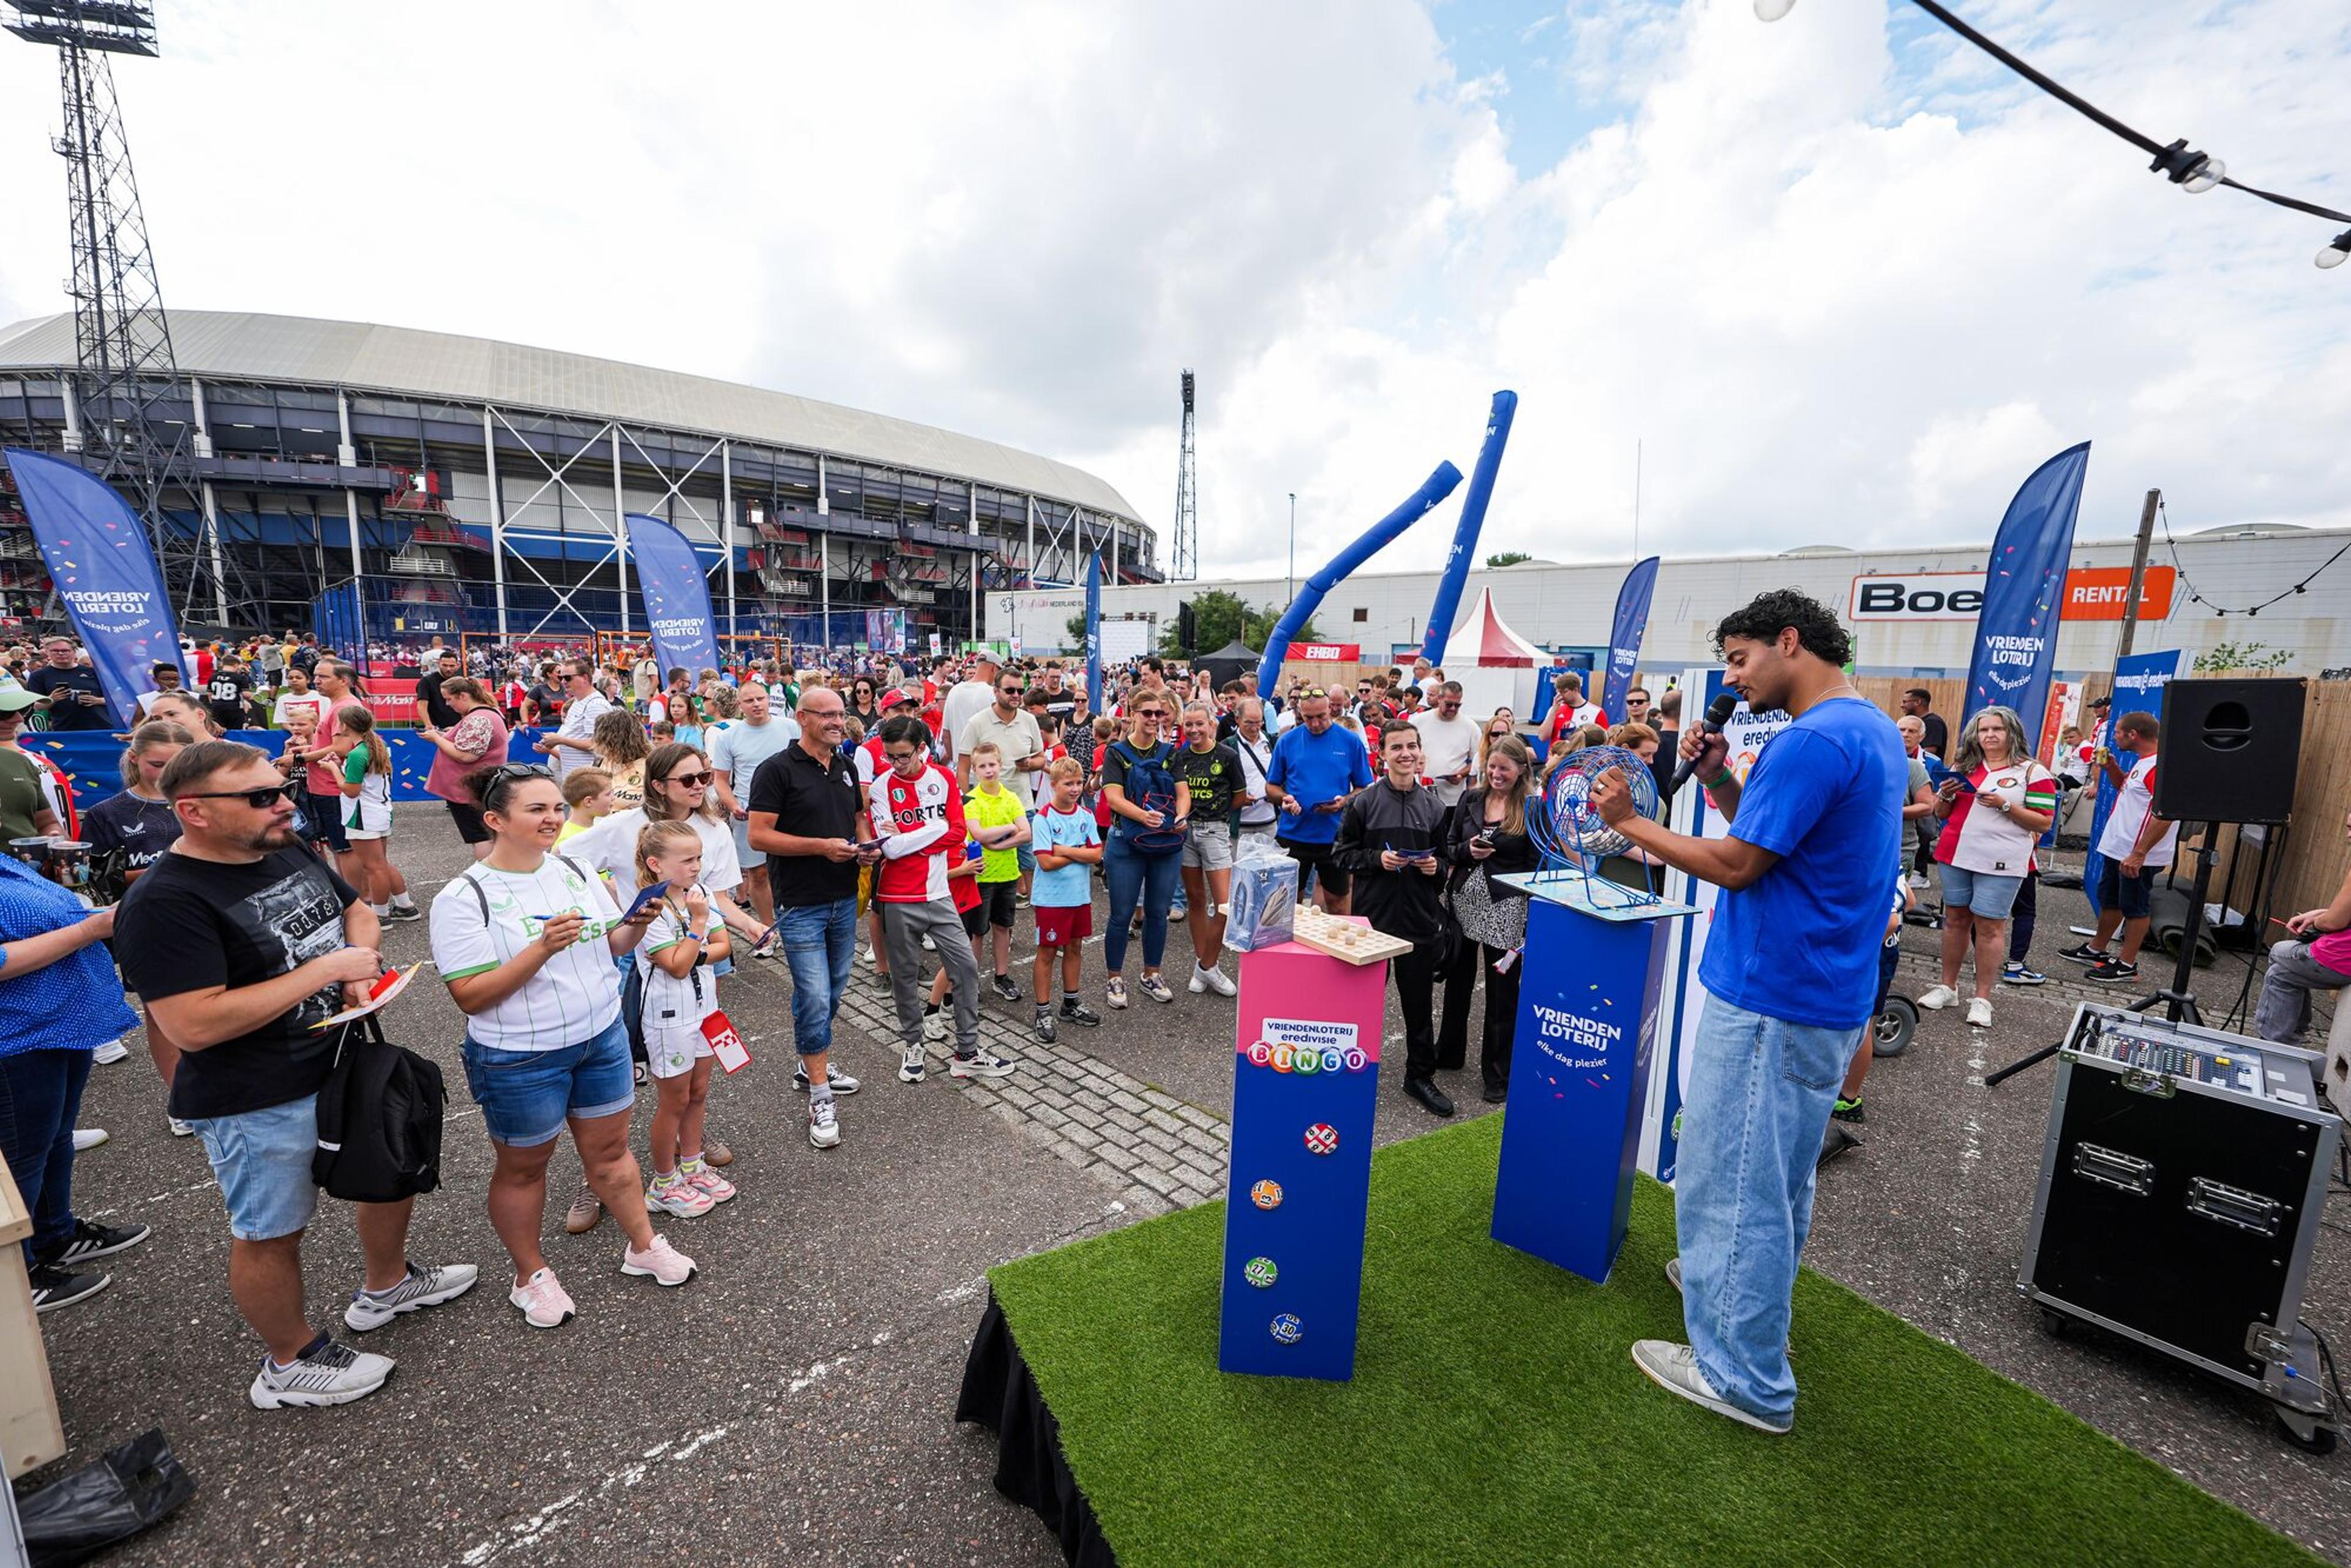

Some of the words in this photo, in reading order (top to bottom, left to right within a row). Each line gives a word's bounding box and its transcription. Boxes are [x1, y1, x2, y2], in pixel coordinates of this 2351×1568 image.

[1858, 583, 1983, 613] Boe
[1305, 645, 1341, 660] EHBO
[1186, 775, 1210, 787] uro
[1190, 788, 1213, 799] arcs
[1267, 1022, 1354, 1036] VRIENDENLOTERIJ
[1532, 1004, 1622, 1041] VRIENDEN
[1281, 1033, 1337, 1045] eredivisie
[1541, 1021, 1608, 1052] LOTERIJ
[1255, 1046, 1362, 1069] BINGO
[1536, 1039, 1554, 1057] elke
[1555, 1052, 1573, 1067] dag
[1575, 1057, 1608, 1068] plezier
[1260, 1195, 1272, 1205] 13
[1251, 1263, 1265, 1275] 27
[1281, 1323, 1295, 1335] 30
